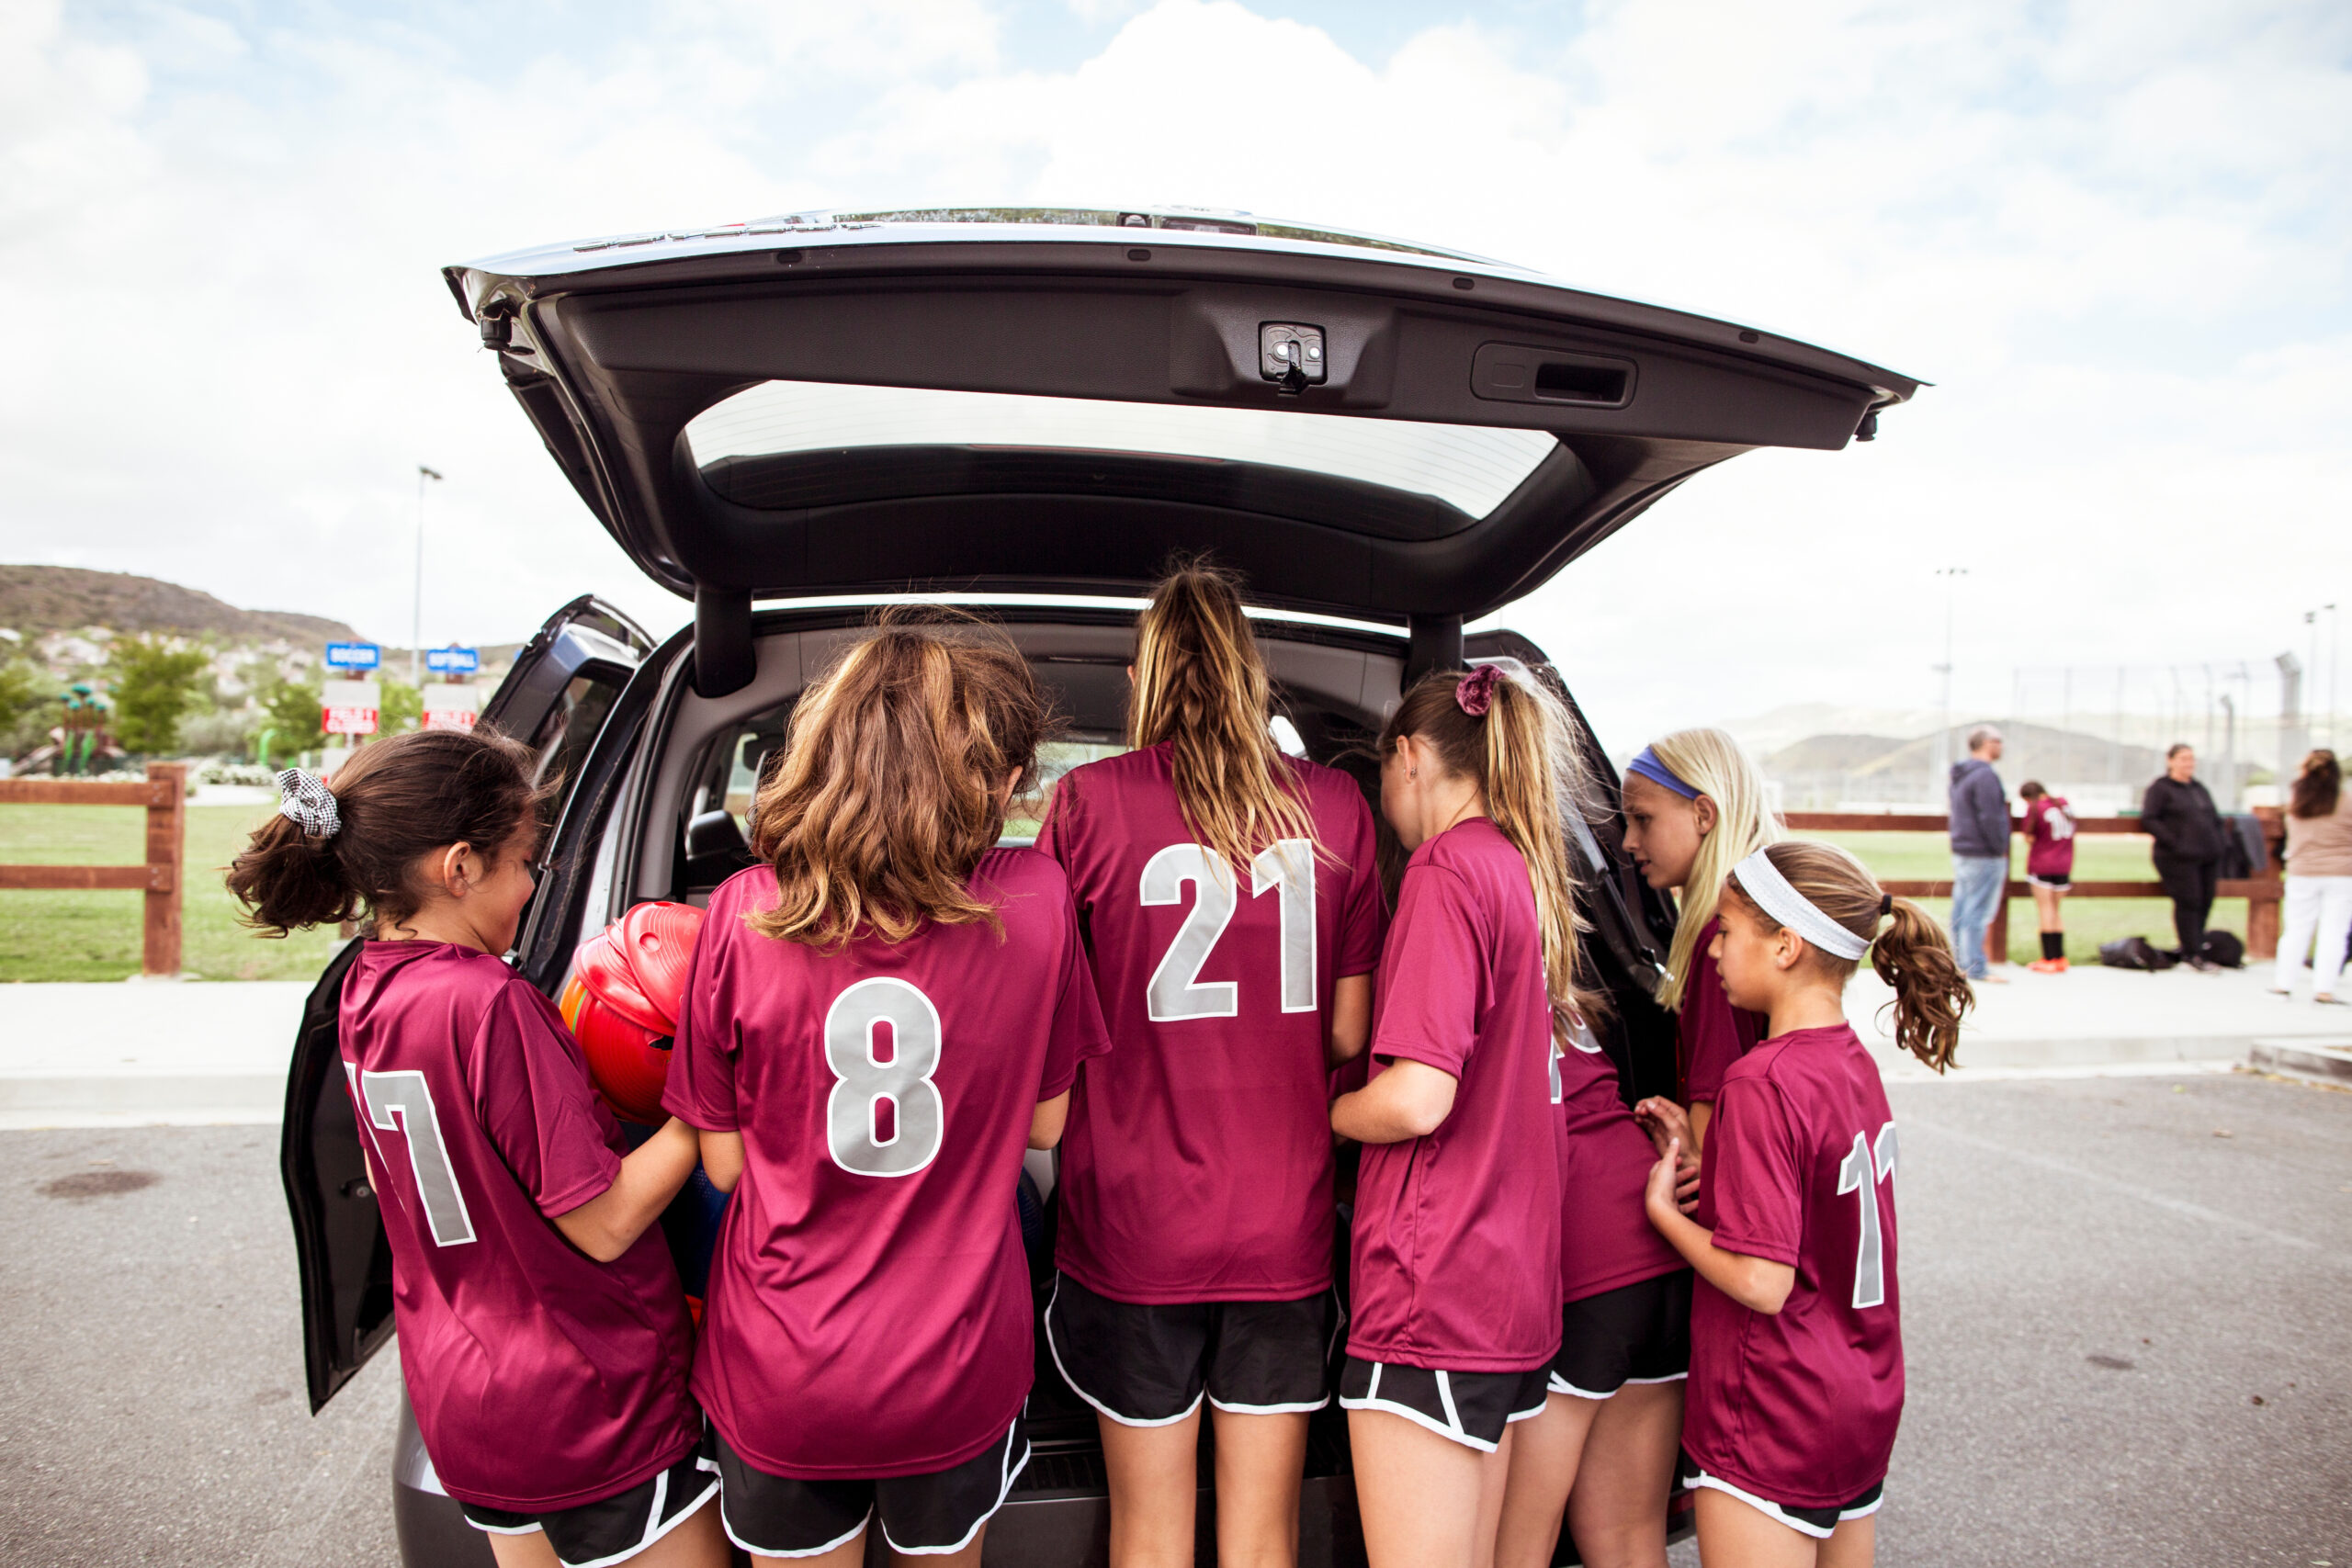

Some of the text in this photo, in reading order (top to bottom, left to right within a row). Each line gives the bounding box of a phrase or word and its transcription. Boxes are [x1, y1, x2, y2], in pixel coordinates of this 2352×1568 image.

[330, 648, 376, 663] SOCCER
[1139, 839, 1317, 1022] 21
[344, 1061, 478, 1247] 7
[824, 976, 944, 1178] 8
